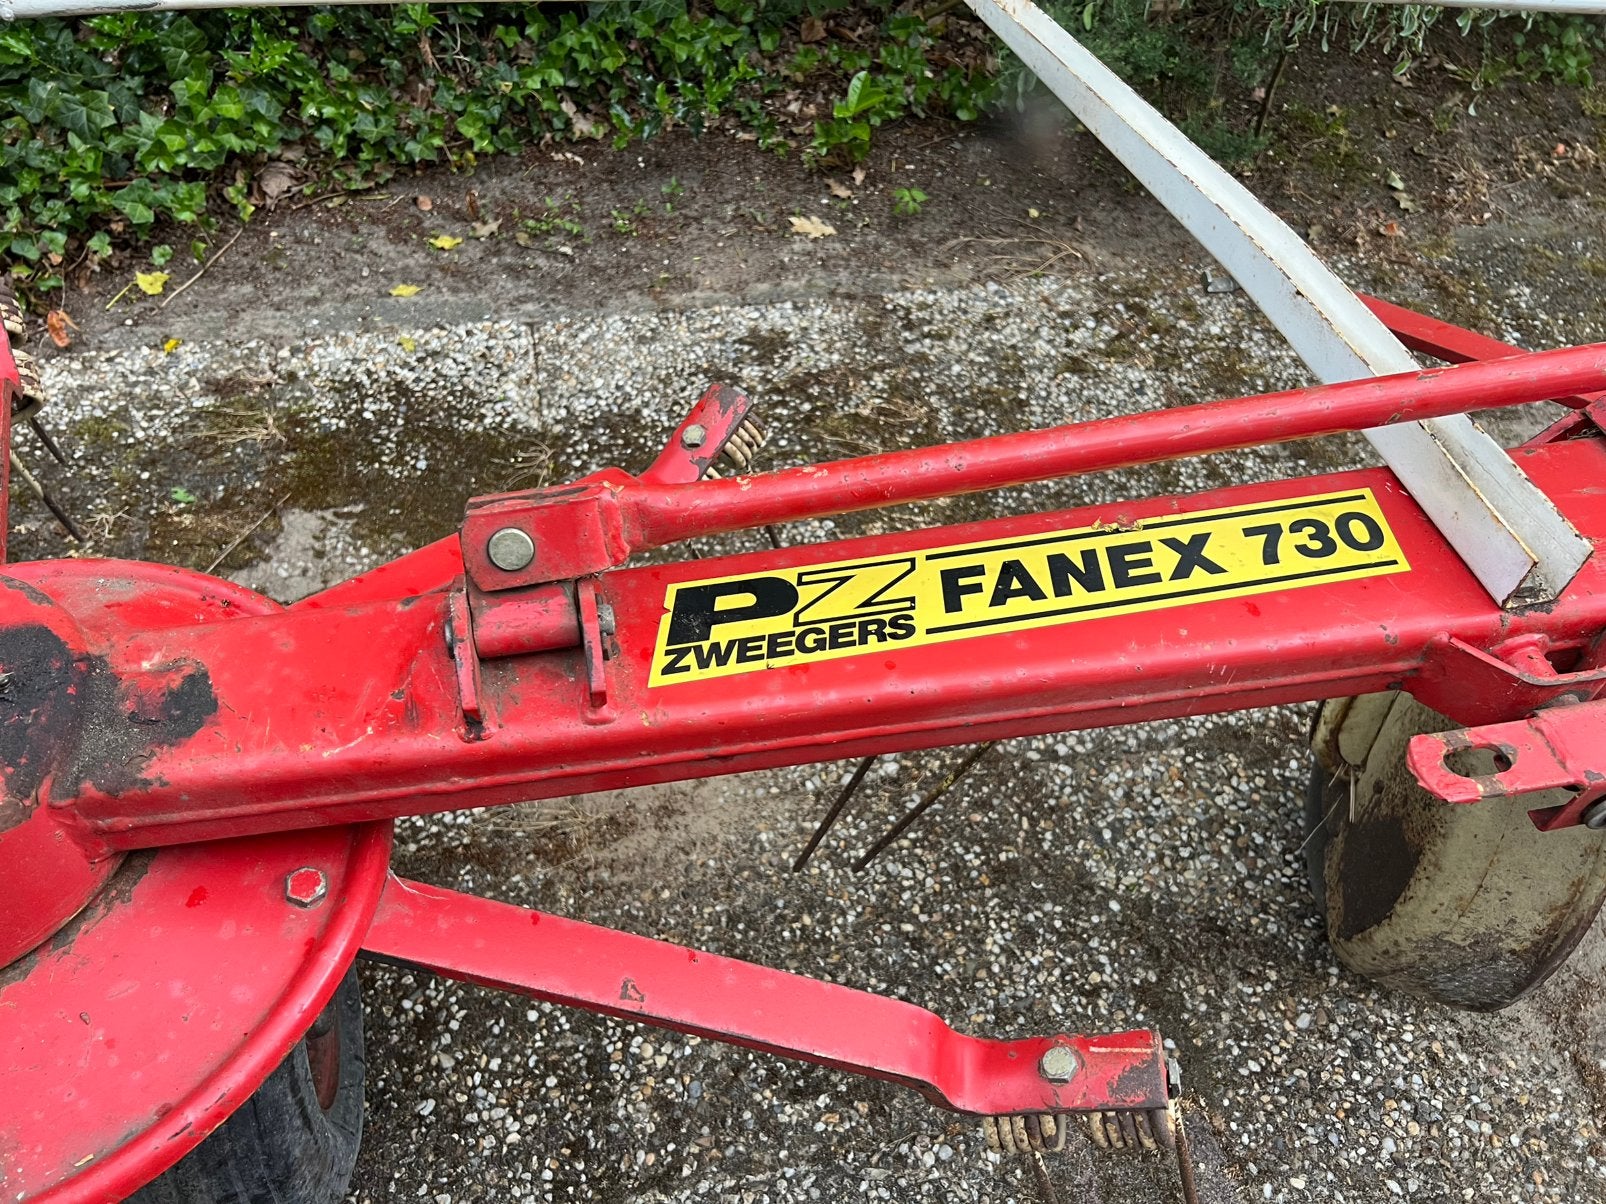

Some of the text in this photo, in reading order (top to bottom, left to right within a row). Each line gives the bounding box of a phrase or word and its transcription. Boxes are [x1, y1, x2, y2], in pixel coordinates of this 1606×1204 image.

[665, 557, 917, 647] PZ
[939, 511, 1385, 614] FANEX 730
[660, 613, 916, 676] ZWEEGERS
